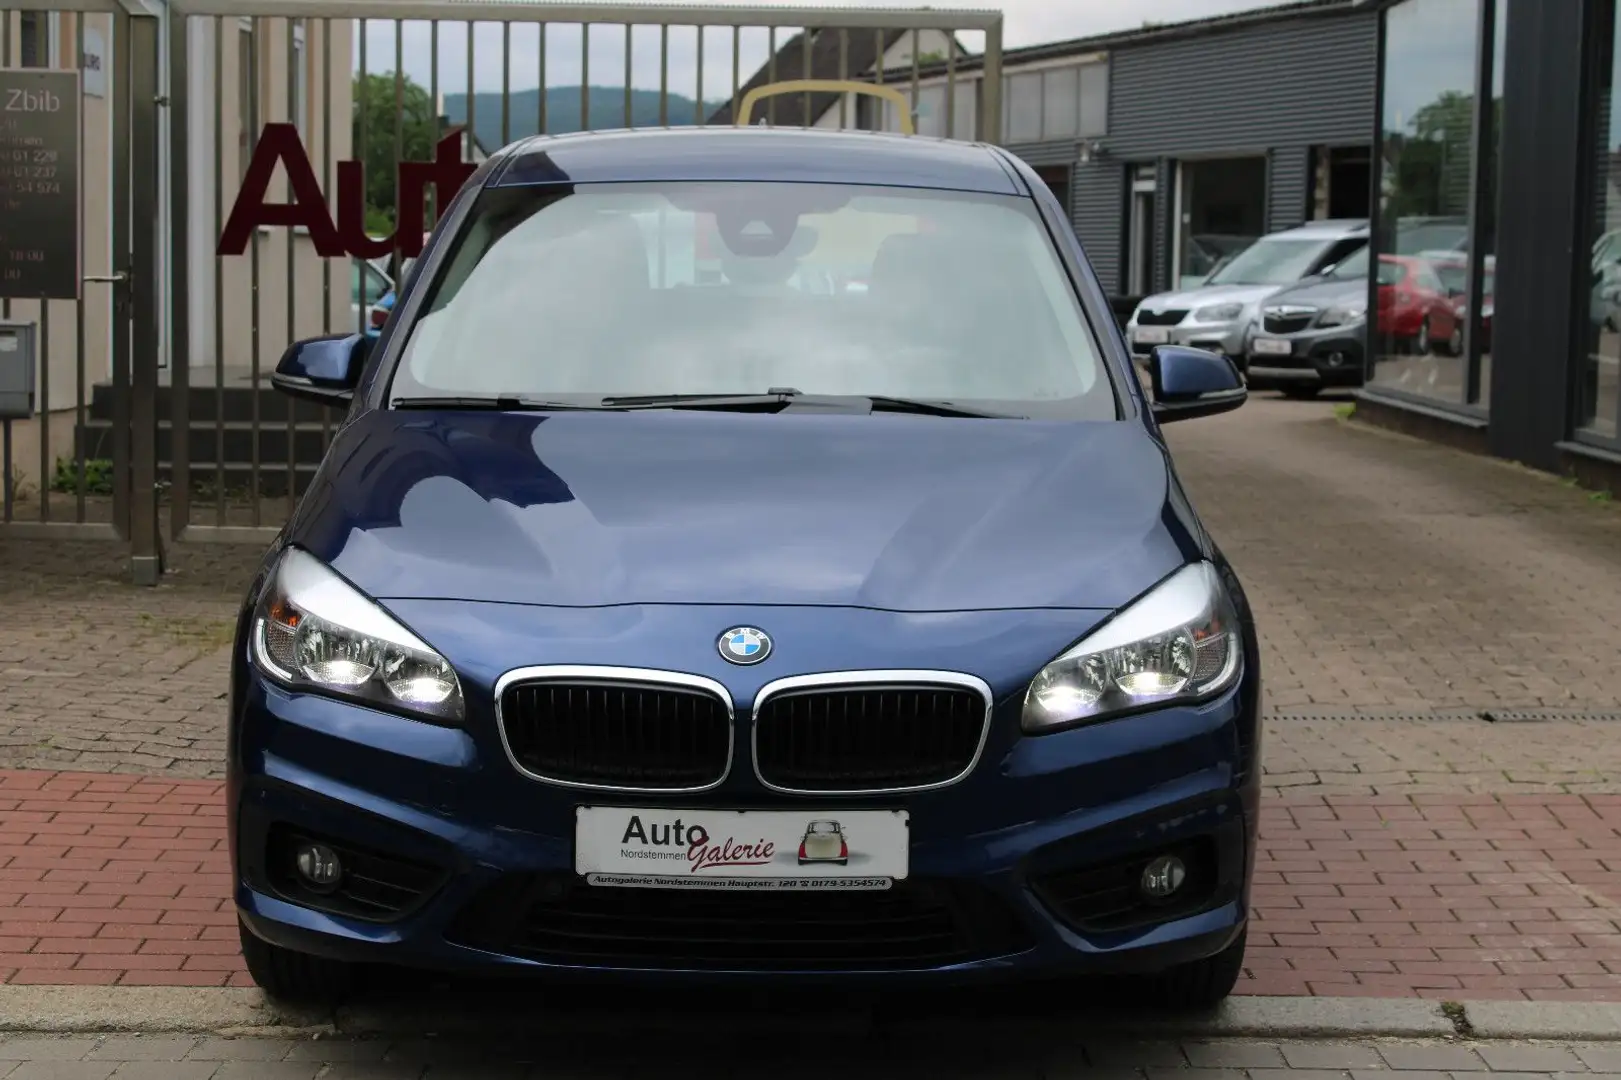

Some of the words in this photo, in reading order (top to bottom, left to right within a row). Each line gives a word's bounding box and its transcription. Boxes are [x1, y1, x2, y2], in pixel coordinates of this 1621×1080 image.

[4, 88, 60, 112] Zbib
[621, 816, 707, 847] Auto
[687, 835, 775, 873] Galerie
[620, 849, 687, 861] Nordstemmen
[594, 875, 652, 886] Autogalerie
[653, 878, 726, 888] Nordstemmen
[727, 879, 775, 889] Hauptstr.
[778, 879, 797, 888] 120
[811, 879, 886, 888] 0179-5354574
